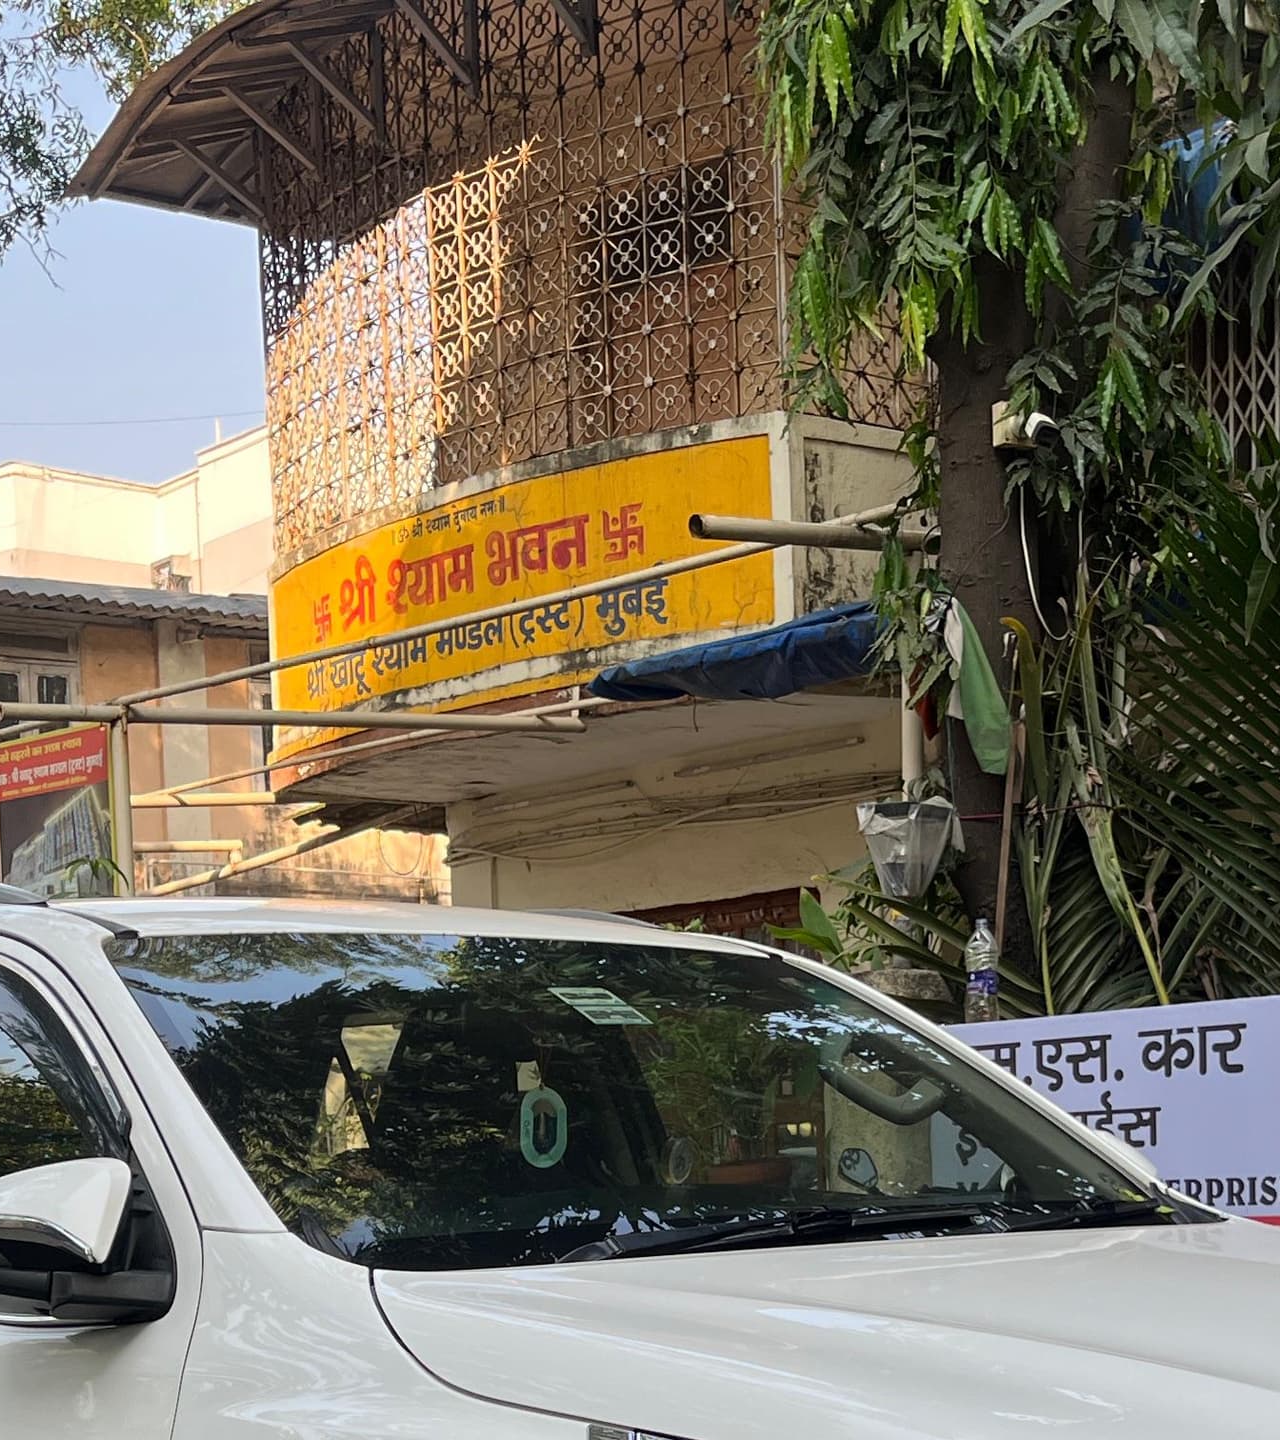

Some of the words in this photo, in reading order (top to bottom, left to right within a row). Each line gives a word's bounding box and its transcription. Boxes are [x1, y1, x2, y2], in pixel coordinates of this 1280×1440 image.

[339, 555, 377, 634] श्री
[386, 542, 475, 615] श्याम
[485, 513, 590, 586] भवन
[372, 636, 427, 676] श्याम
[1138, 1022, 1248, 1078] कार
